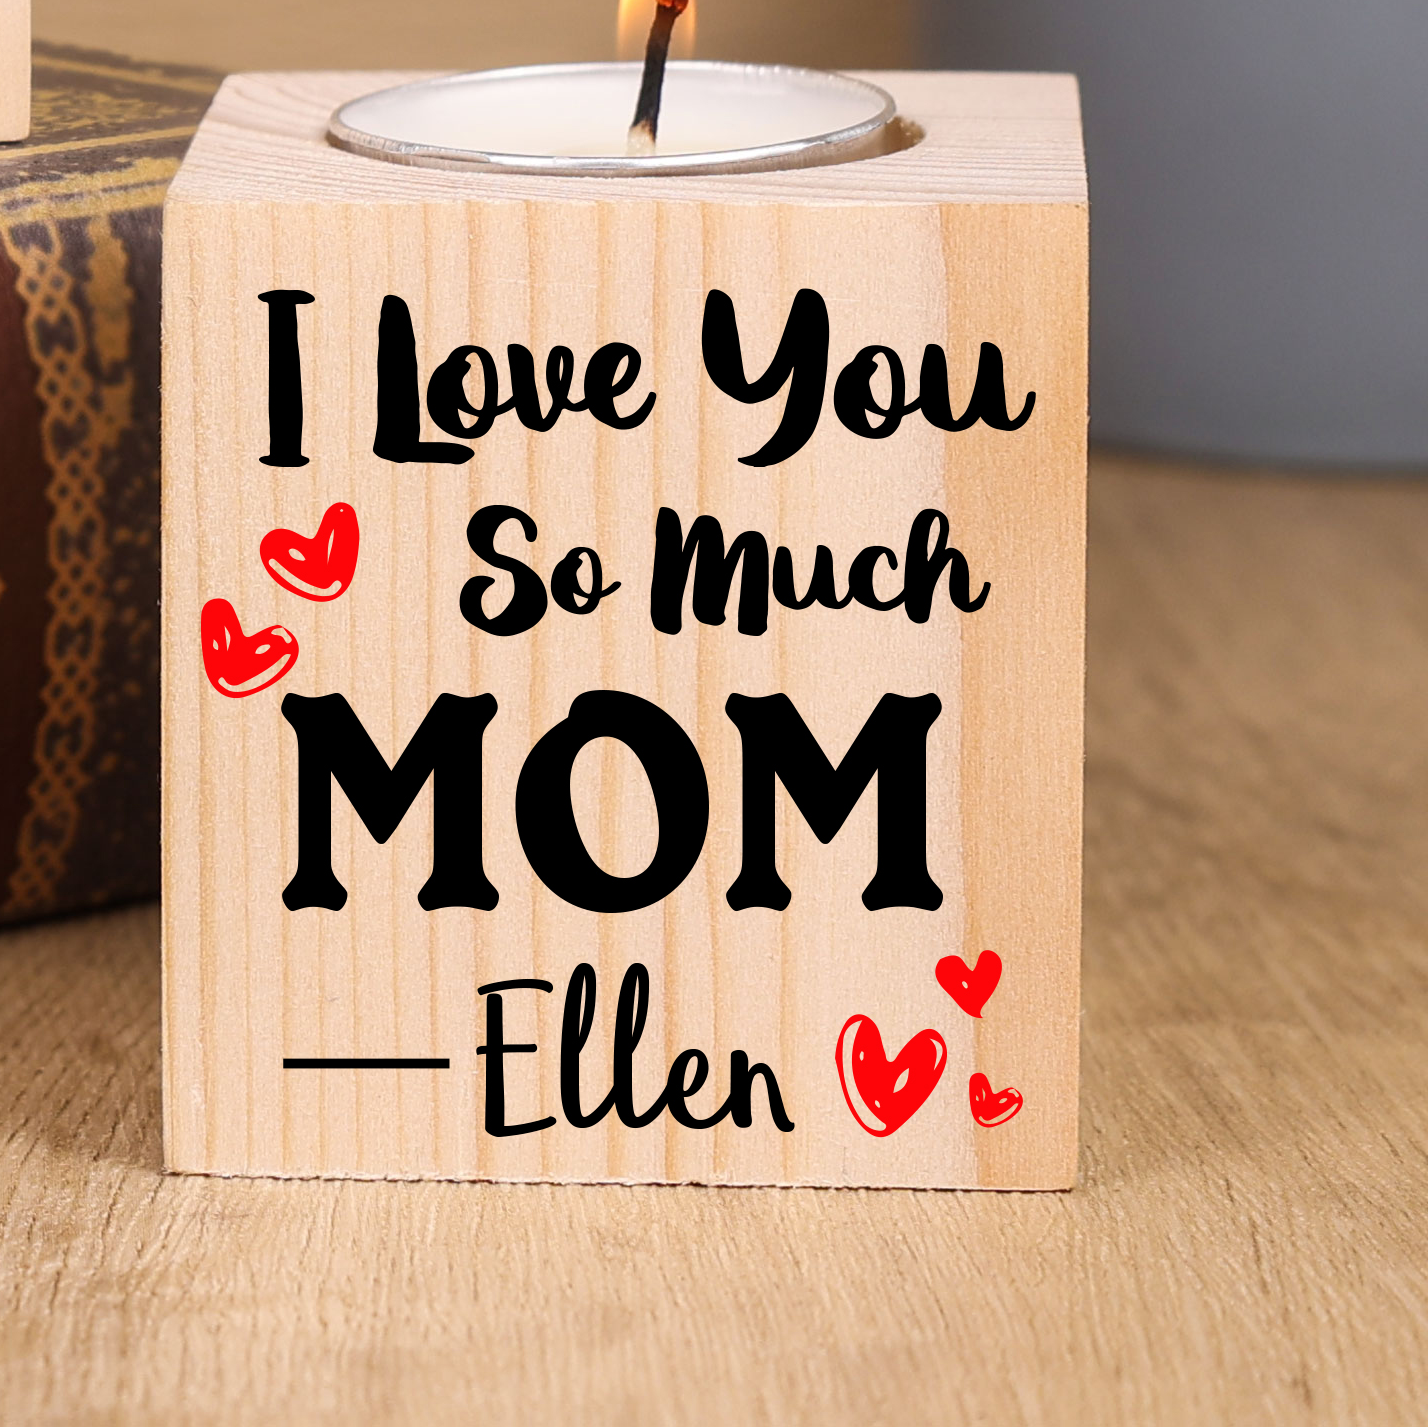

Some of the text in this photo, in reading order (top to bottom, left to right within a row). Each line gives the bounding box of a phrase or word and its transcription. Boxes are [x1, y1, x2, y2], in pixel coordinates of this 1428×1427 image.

[258, 289, 1037, 468] I Love You
[460, 505, 992, 637] So Much
[281, 690, 944, 914] MOM
